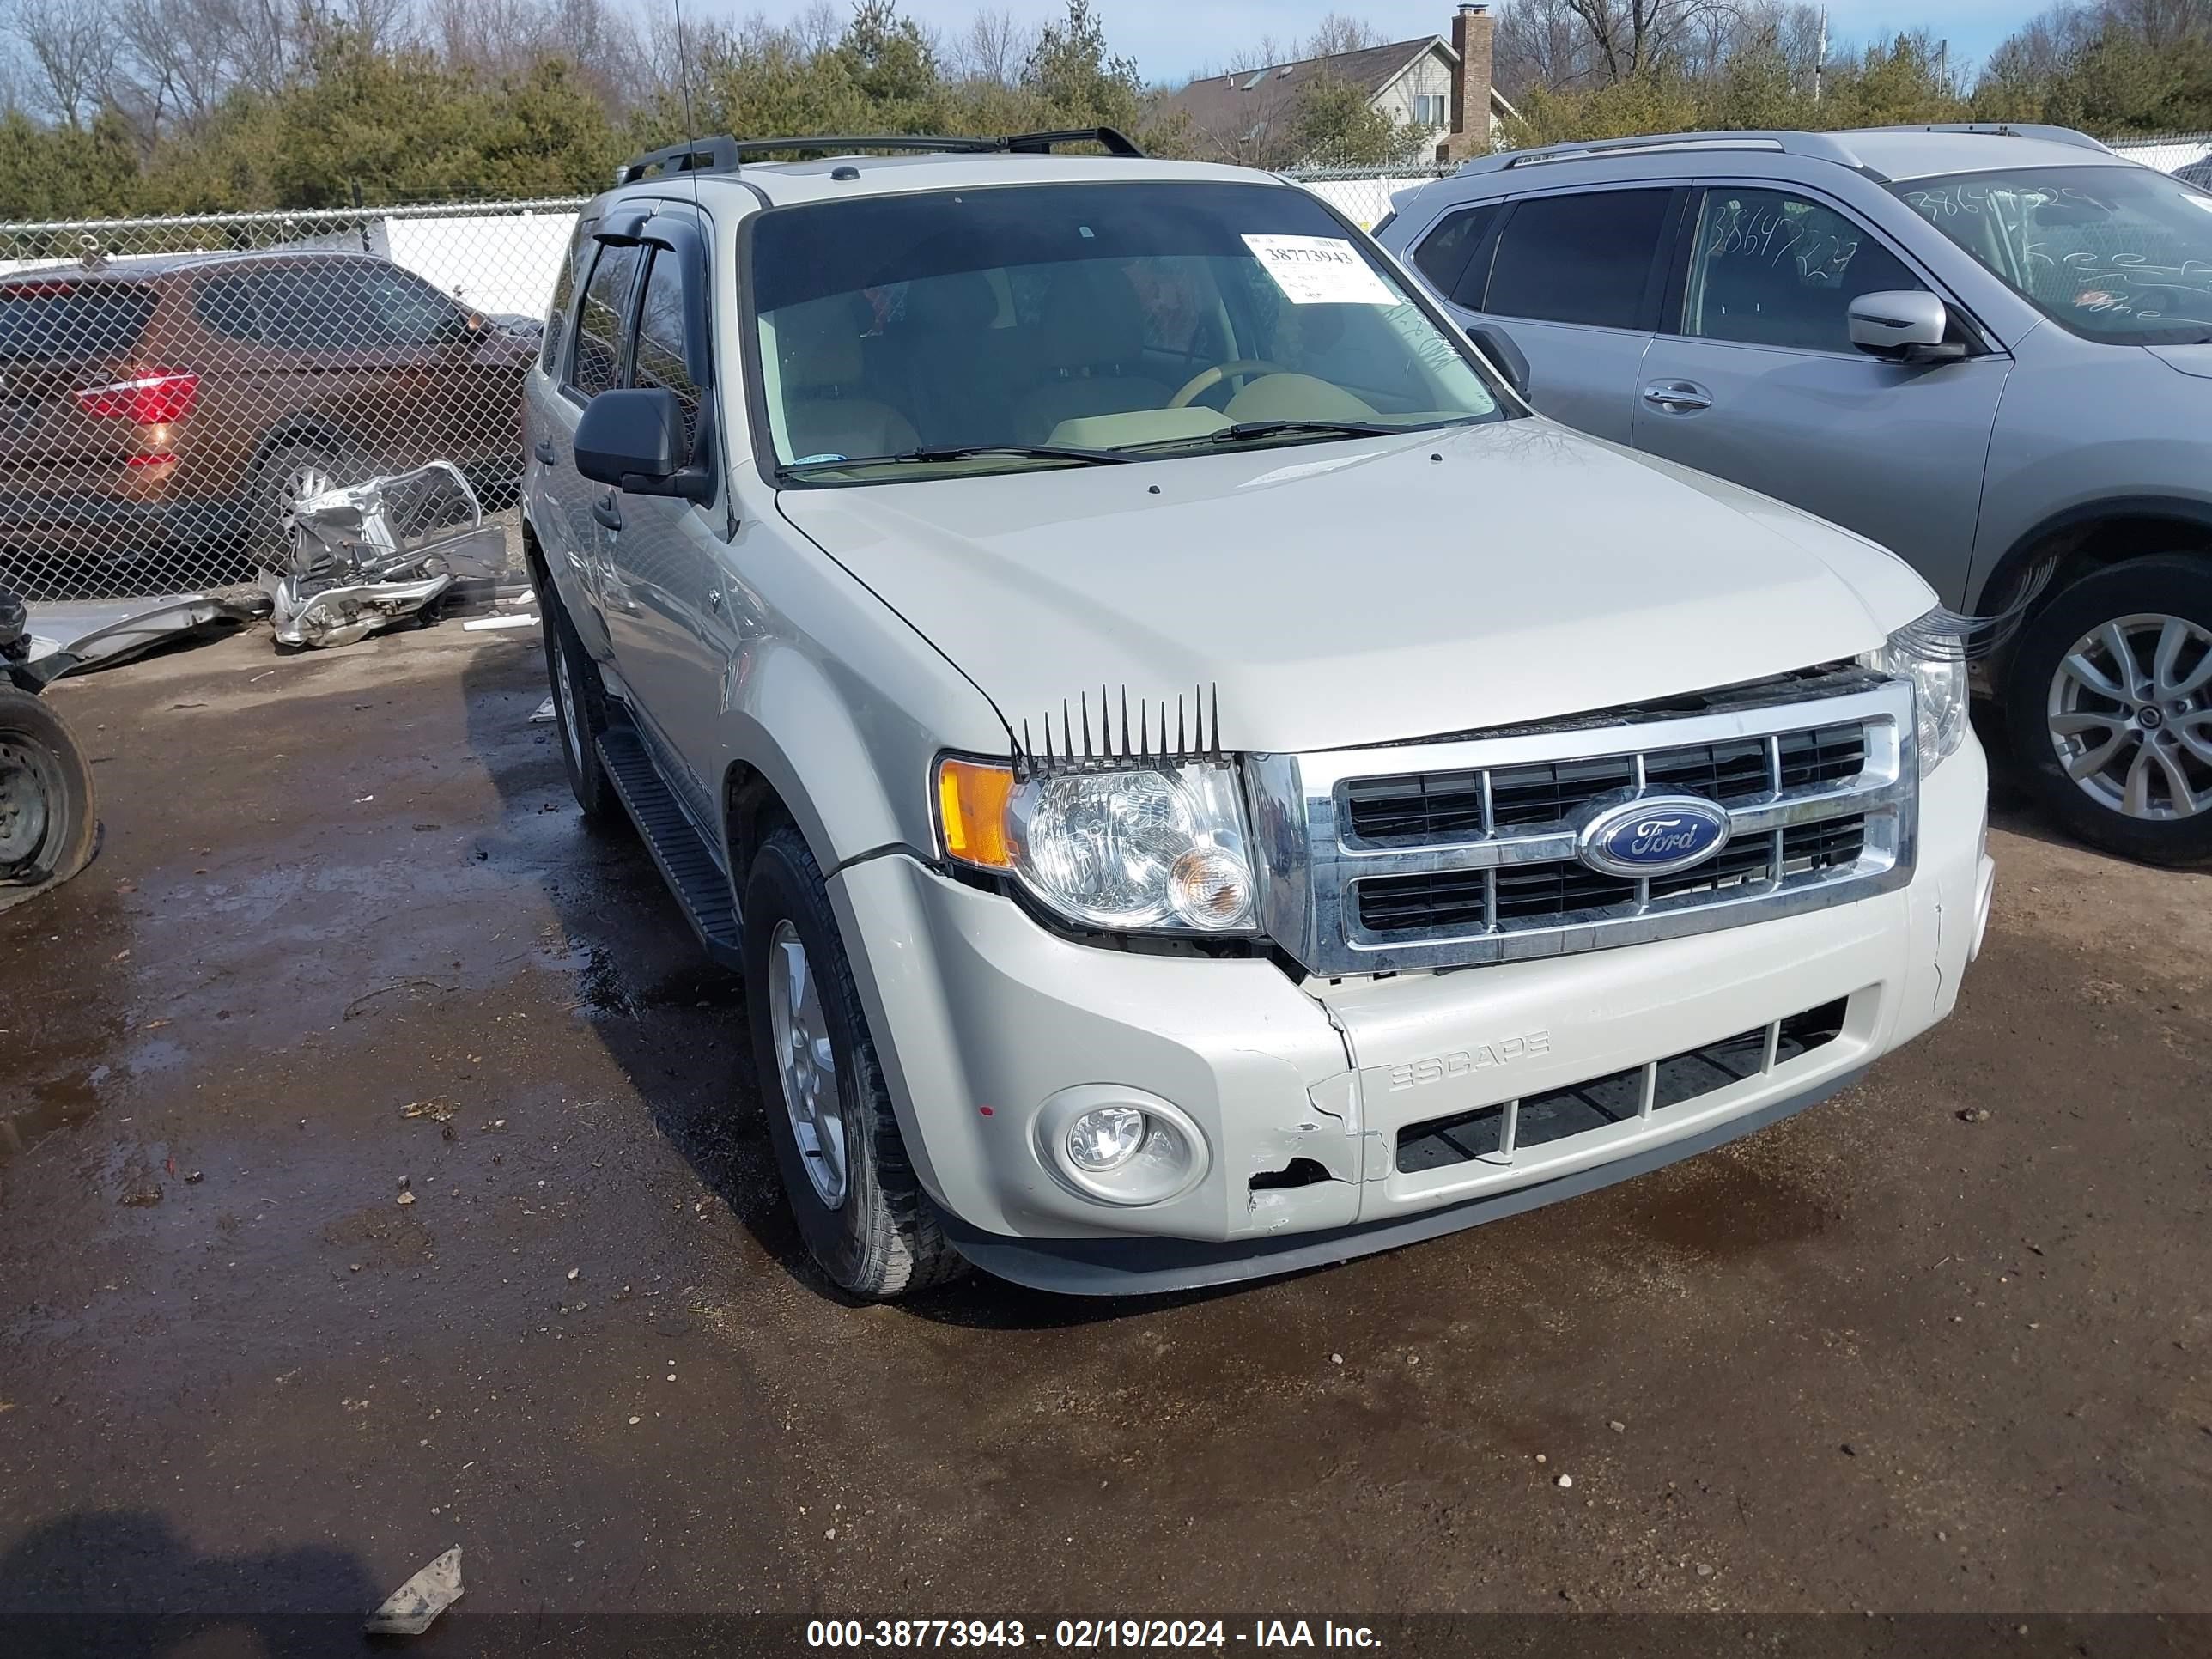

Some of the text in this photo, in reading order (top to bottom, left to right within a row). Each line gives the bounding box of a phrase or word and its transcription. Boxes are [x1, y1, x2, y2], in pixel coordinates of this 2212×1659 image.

[1265, 248, 1354, 265] 38773943
[1632, 818, 1698, 855] Ford
[1388, 1030, 1550, 1093] ESCAPE
